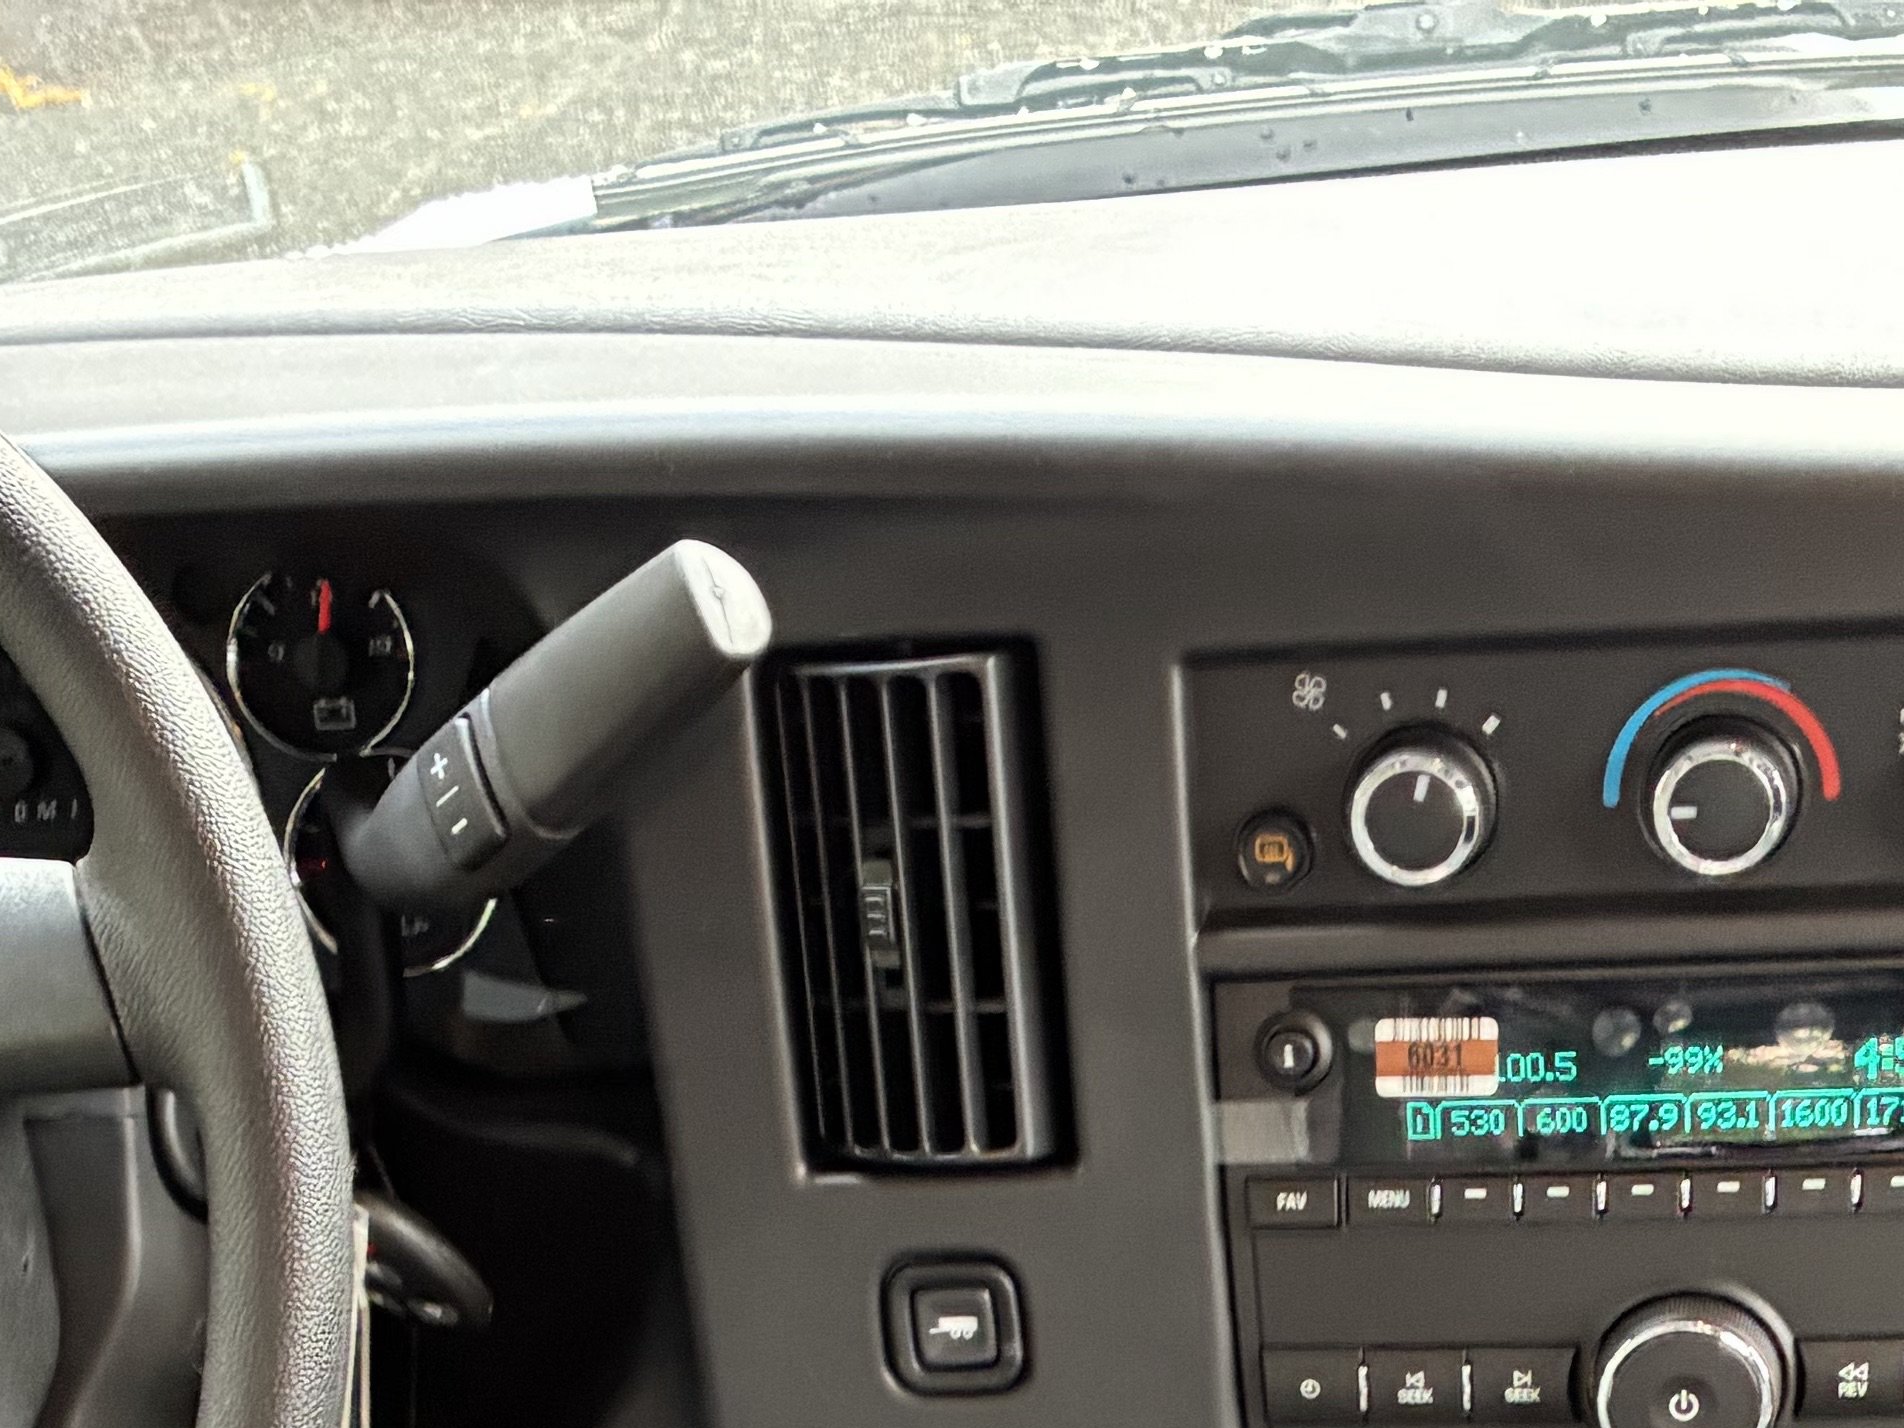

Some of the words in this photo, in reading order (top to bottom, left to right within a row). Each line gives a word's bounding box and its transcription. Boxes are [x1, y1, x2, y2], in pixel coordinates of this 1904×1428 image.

[1451, 1110, 1505, 1135] 530
[1537, 1107, 1587, 1135] 600
[1610, 1102, 1679, 1133] 87.9
[1696, 1100, 1760, 1130] 93.1
[1781, 1097, 1847, 1128] 1600
[1277, 1191, 1307, 1211] FAV
[1368, 1189, 1411, 1209] MENU
